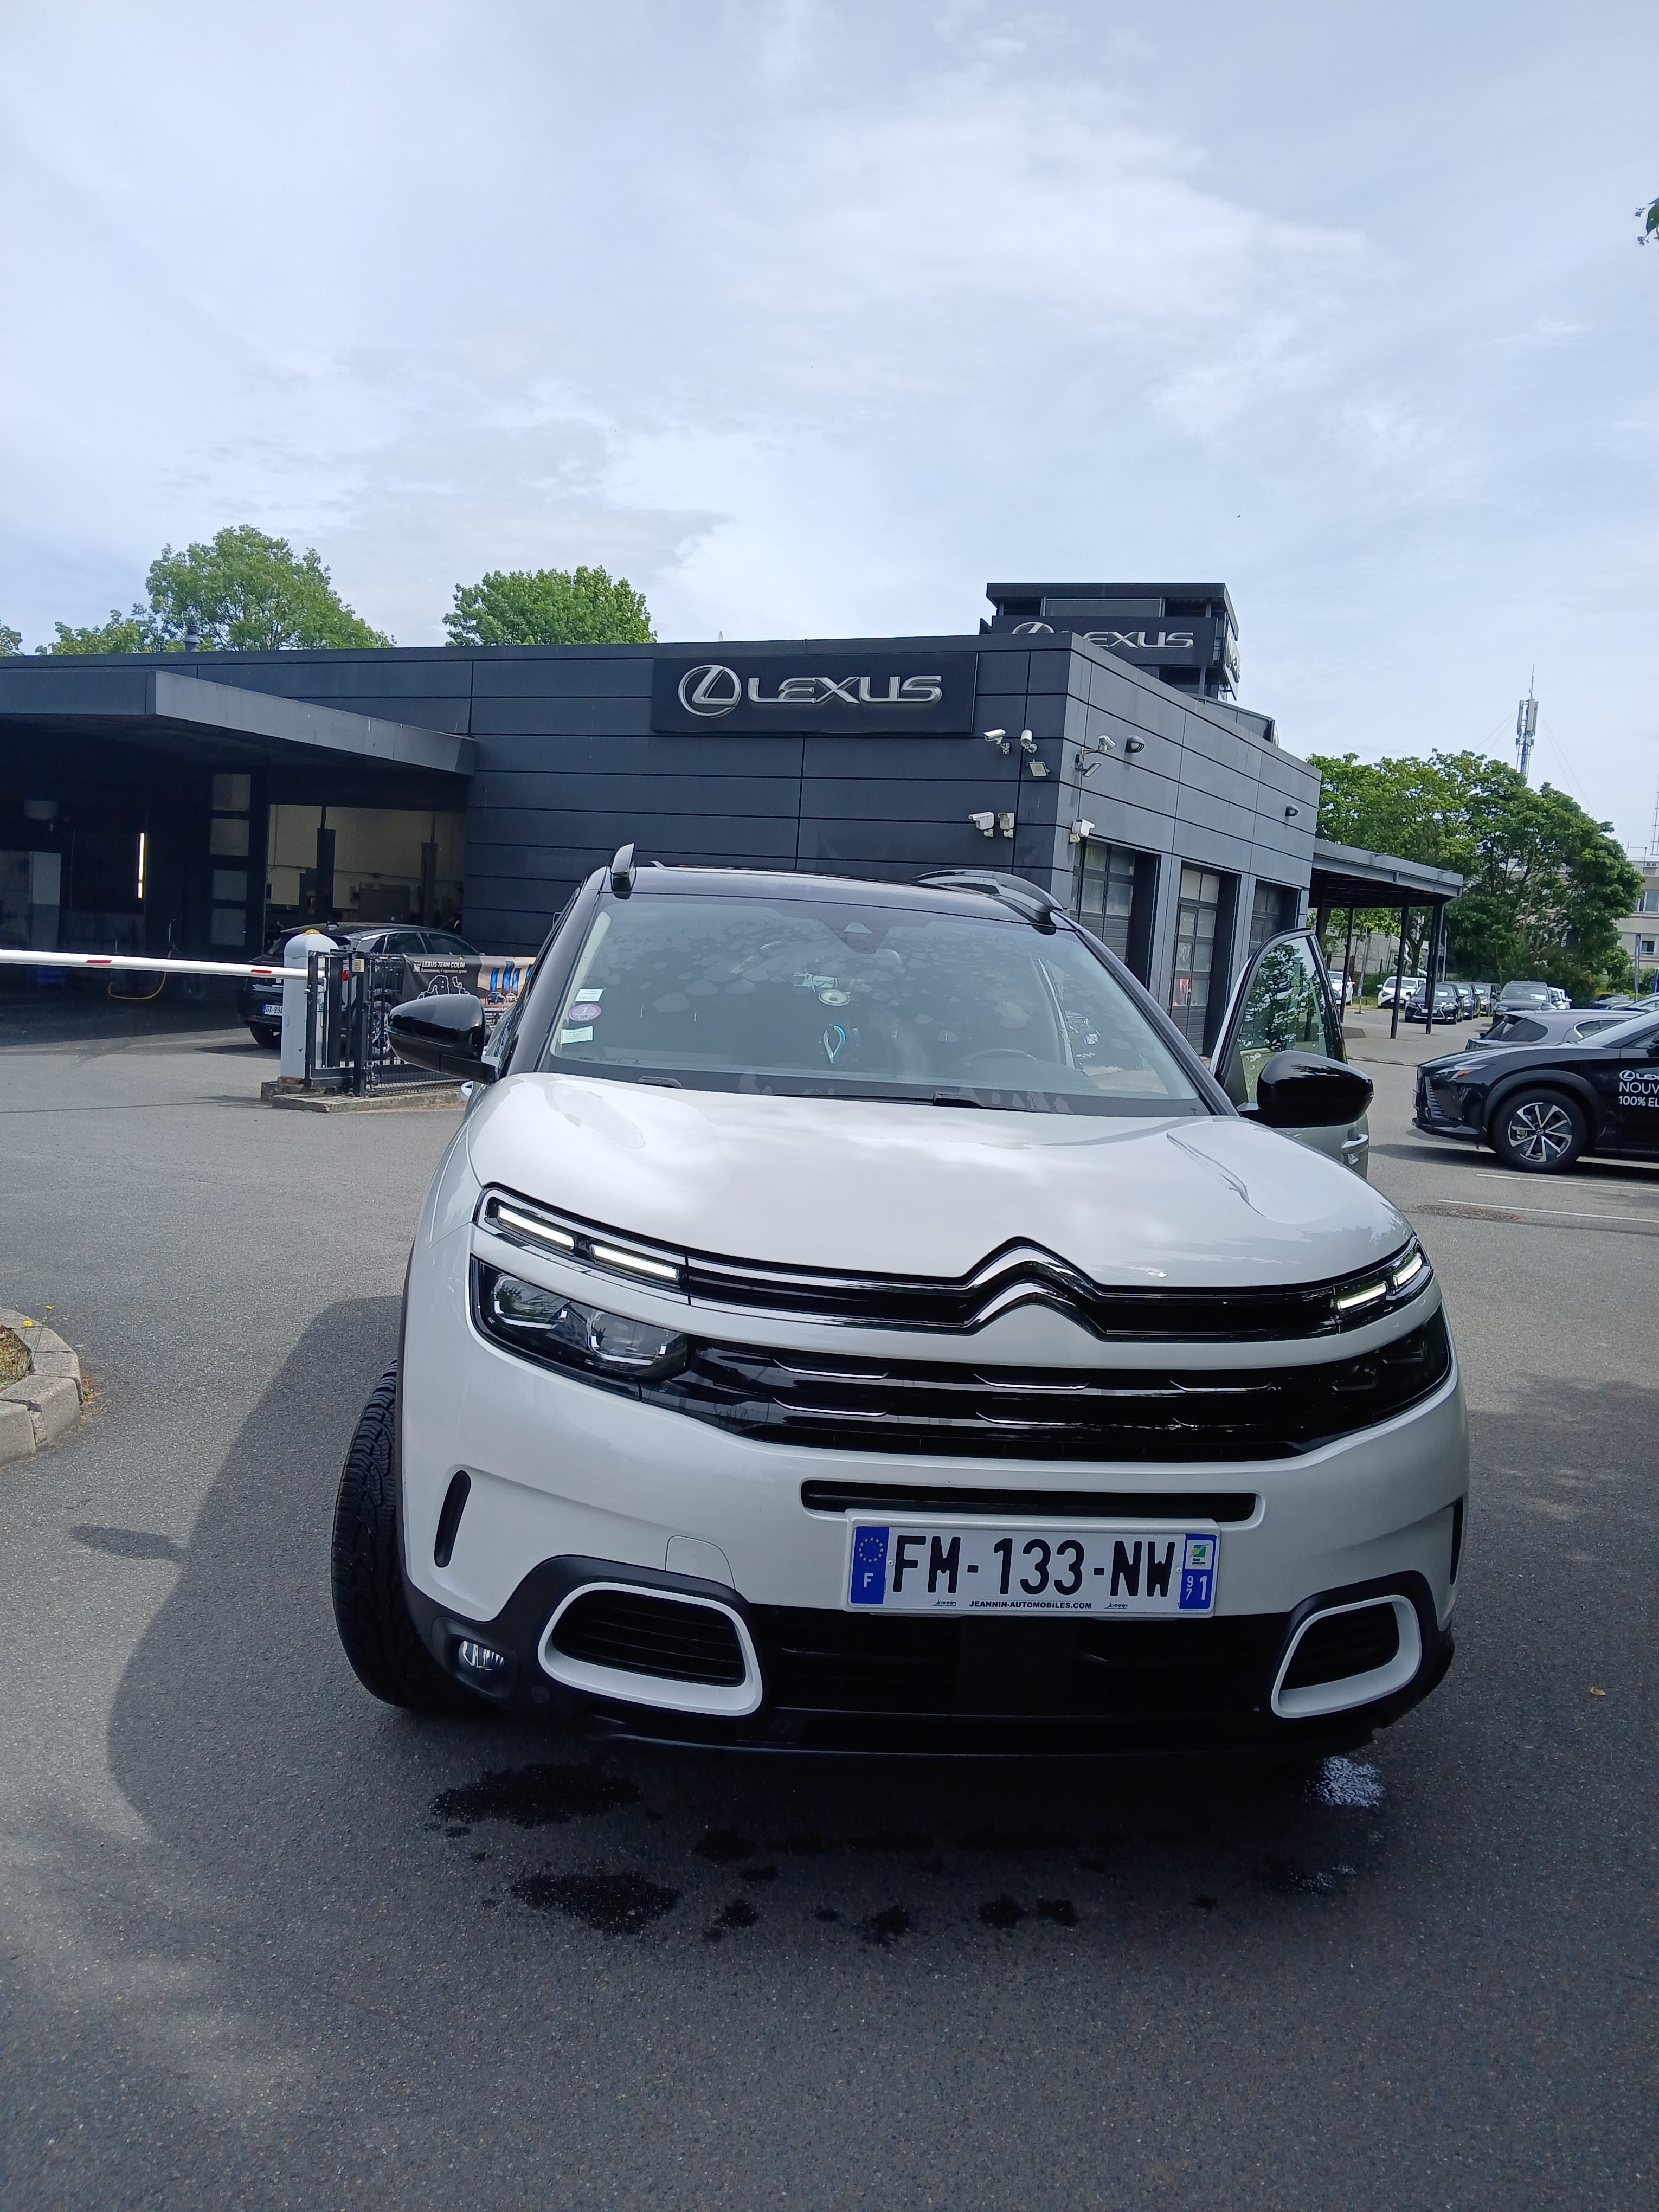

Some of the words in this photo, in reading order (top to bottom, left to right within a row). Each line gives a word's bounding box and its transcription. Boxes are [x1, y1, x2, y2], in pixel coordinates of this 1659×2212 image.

[1061, 631, 1194, 649] EXUS
[748, 676, 942, 704] LEXUS
[1618, 1095, 1647, 1107] 100%
[893, 1535, 1176, 1597] FM-133-NW
[863, 1572, 874, 1588] F
[968, 1600, 1092, 1609] JEANNIN-AUTOMOBILES.COM
